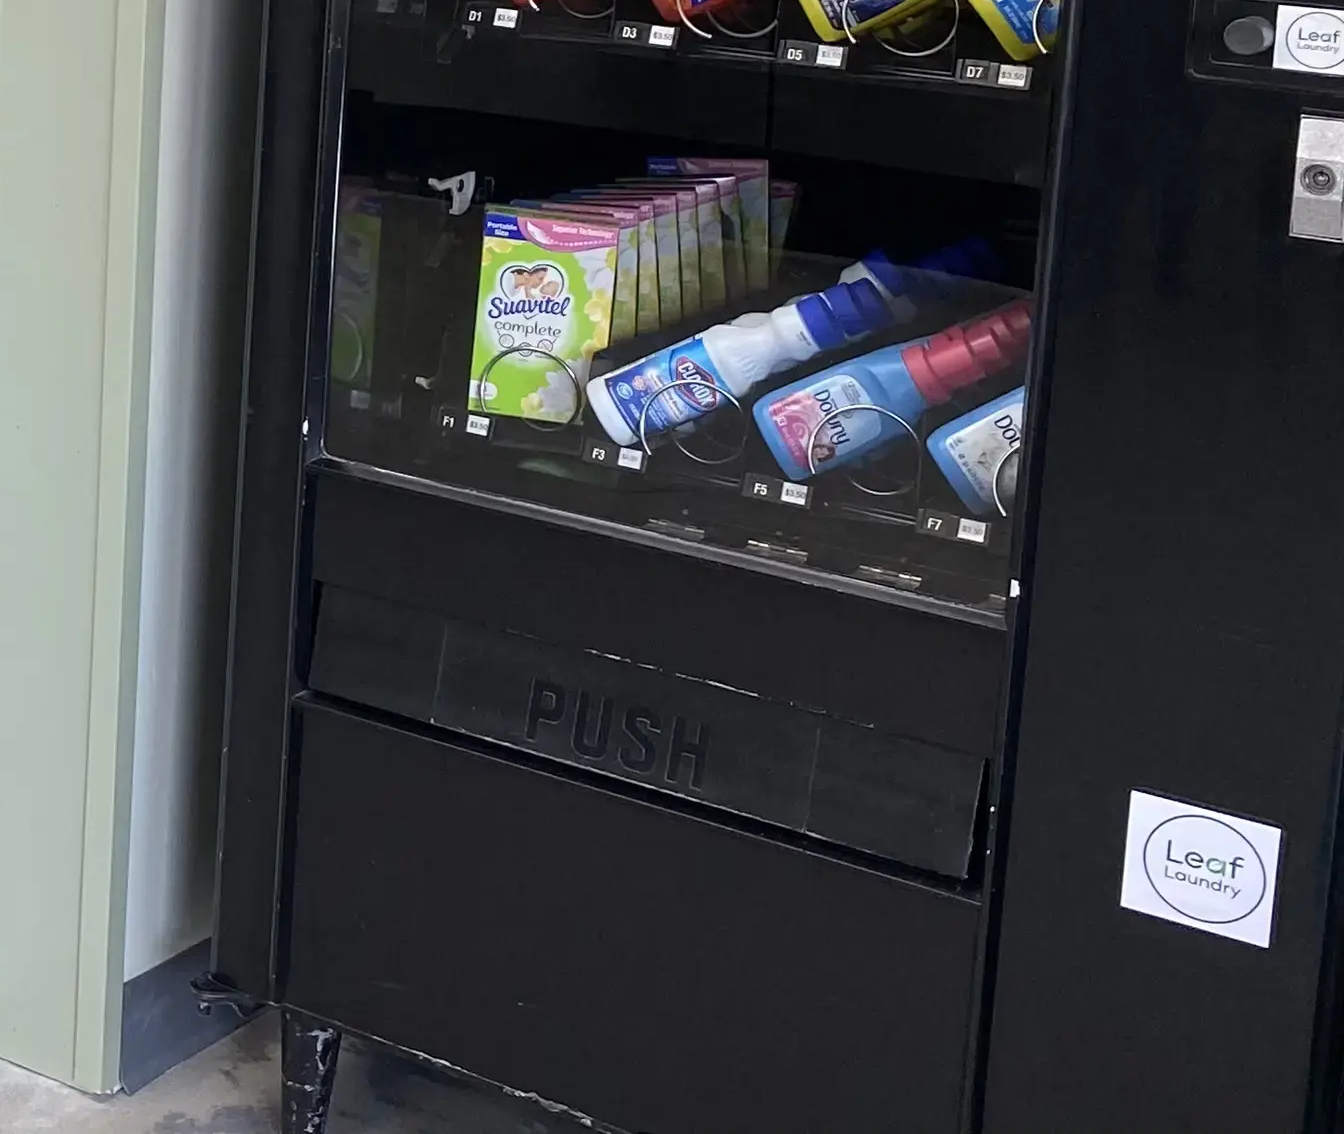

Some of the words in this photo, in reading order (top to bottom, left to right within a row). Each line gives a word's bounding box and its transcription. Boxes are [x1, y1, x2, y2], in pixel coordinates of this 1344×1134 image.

[468, 10, 482, 22] D1
[622, 26, 638, 39] D3
[1298, 27, 1341, 44] Leaf
[786, 48, 803, 61] D5
[1297, 42, 1340, 55] Laundry
[966, 66, 984, 79] D7
[1000, 71, 1024, 80] $3.50
[486, 220, 518, 231] Portable
[488, 296, 571, 319] Suavitel
[494, 320, 562, 338] complete
[442, 415, 455, 428] F1
[591, 447, 606, 461] F3
[753, 482, 768, 496] F5
[927, 517, 943, 531] F7
[524, 676, 711, 793] PUSH
[1166, 839, 1245, 879] Leaf
[1164, 865, 1242, 900] Laundry
